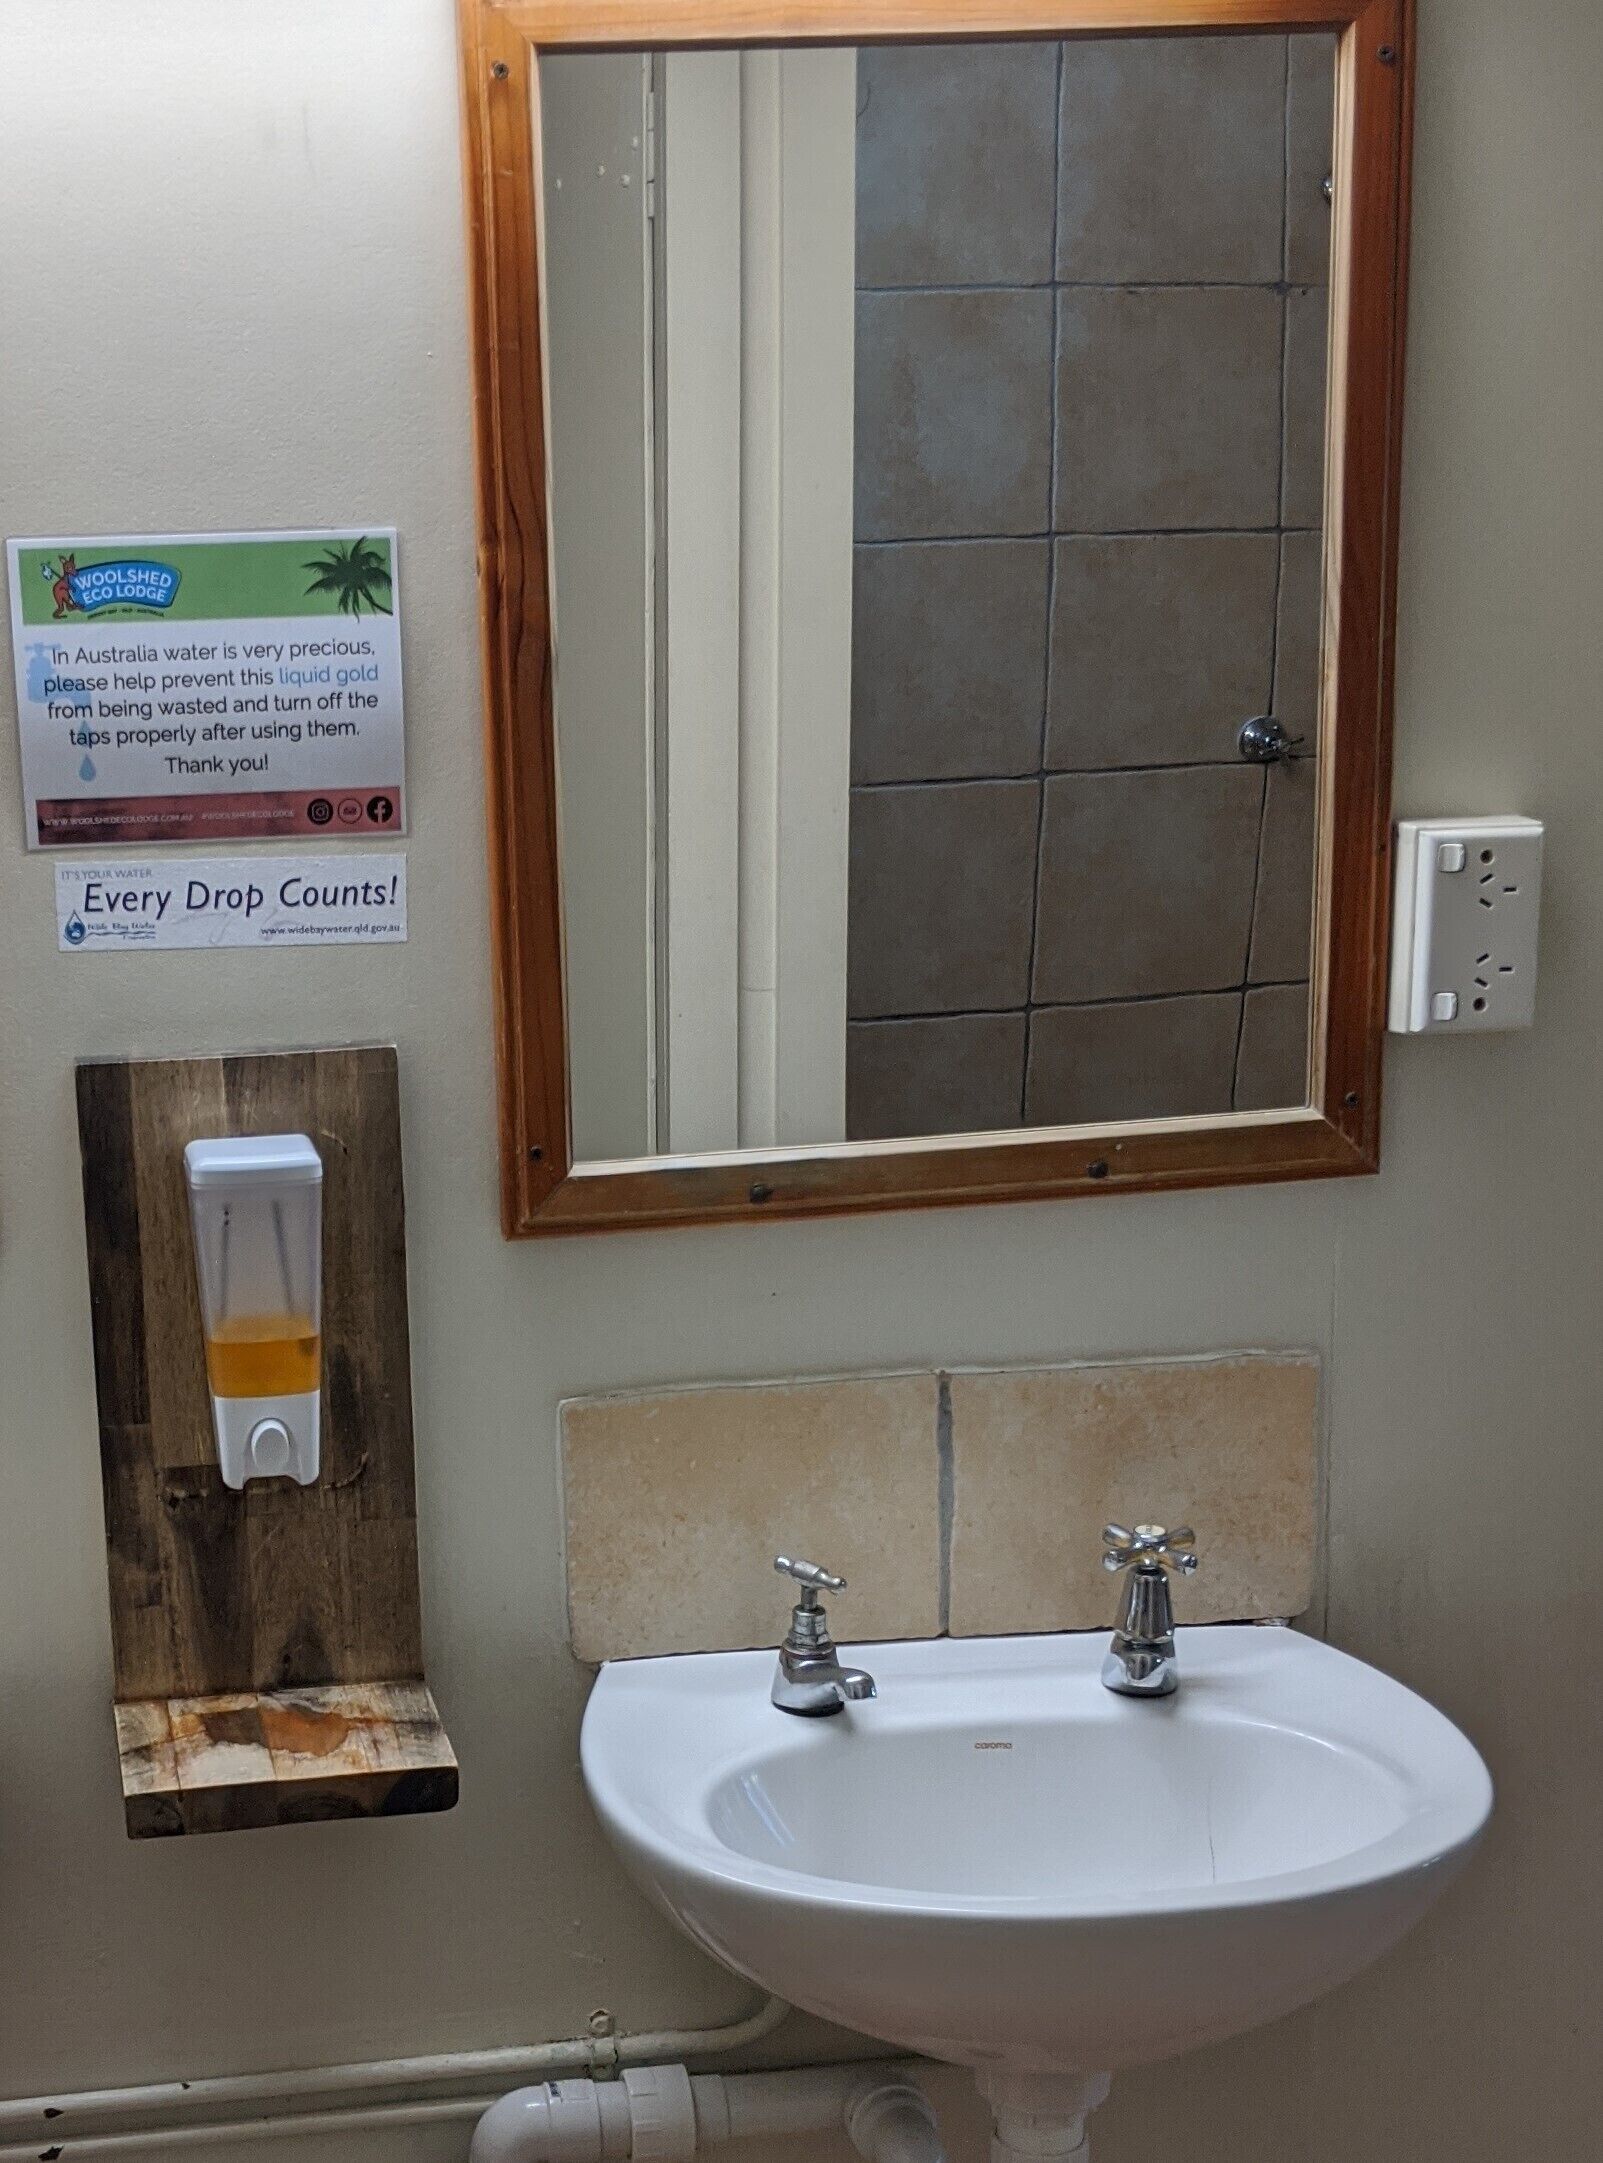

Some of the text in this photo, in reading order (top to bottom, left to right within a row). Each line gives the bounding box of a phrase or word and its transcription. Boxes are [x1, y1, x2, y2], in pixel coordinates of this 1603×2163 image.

[75, 568, 172, 590] WOOLSHED
[83, 584, 167, 605] ECO LODGE
[52, 639, 375, 665] In Australia water is very precious,
[44, 664, 379, 696] please help prevent this liquid gold
[48, 691, 378, 721] from being wasted and turn off the
[69, 719, 360, 749] taps properly after using them.
[165, 754, 268, 776] Thank you!
[61, 869, 152, 880] IT'S YOUR WATER
[84, 875, 398, 920] Every Drop Counts!
[261, 923, 400, 936] www.widebaywater.qld.gov.au
